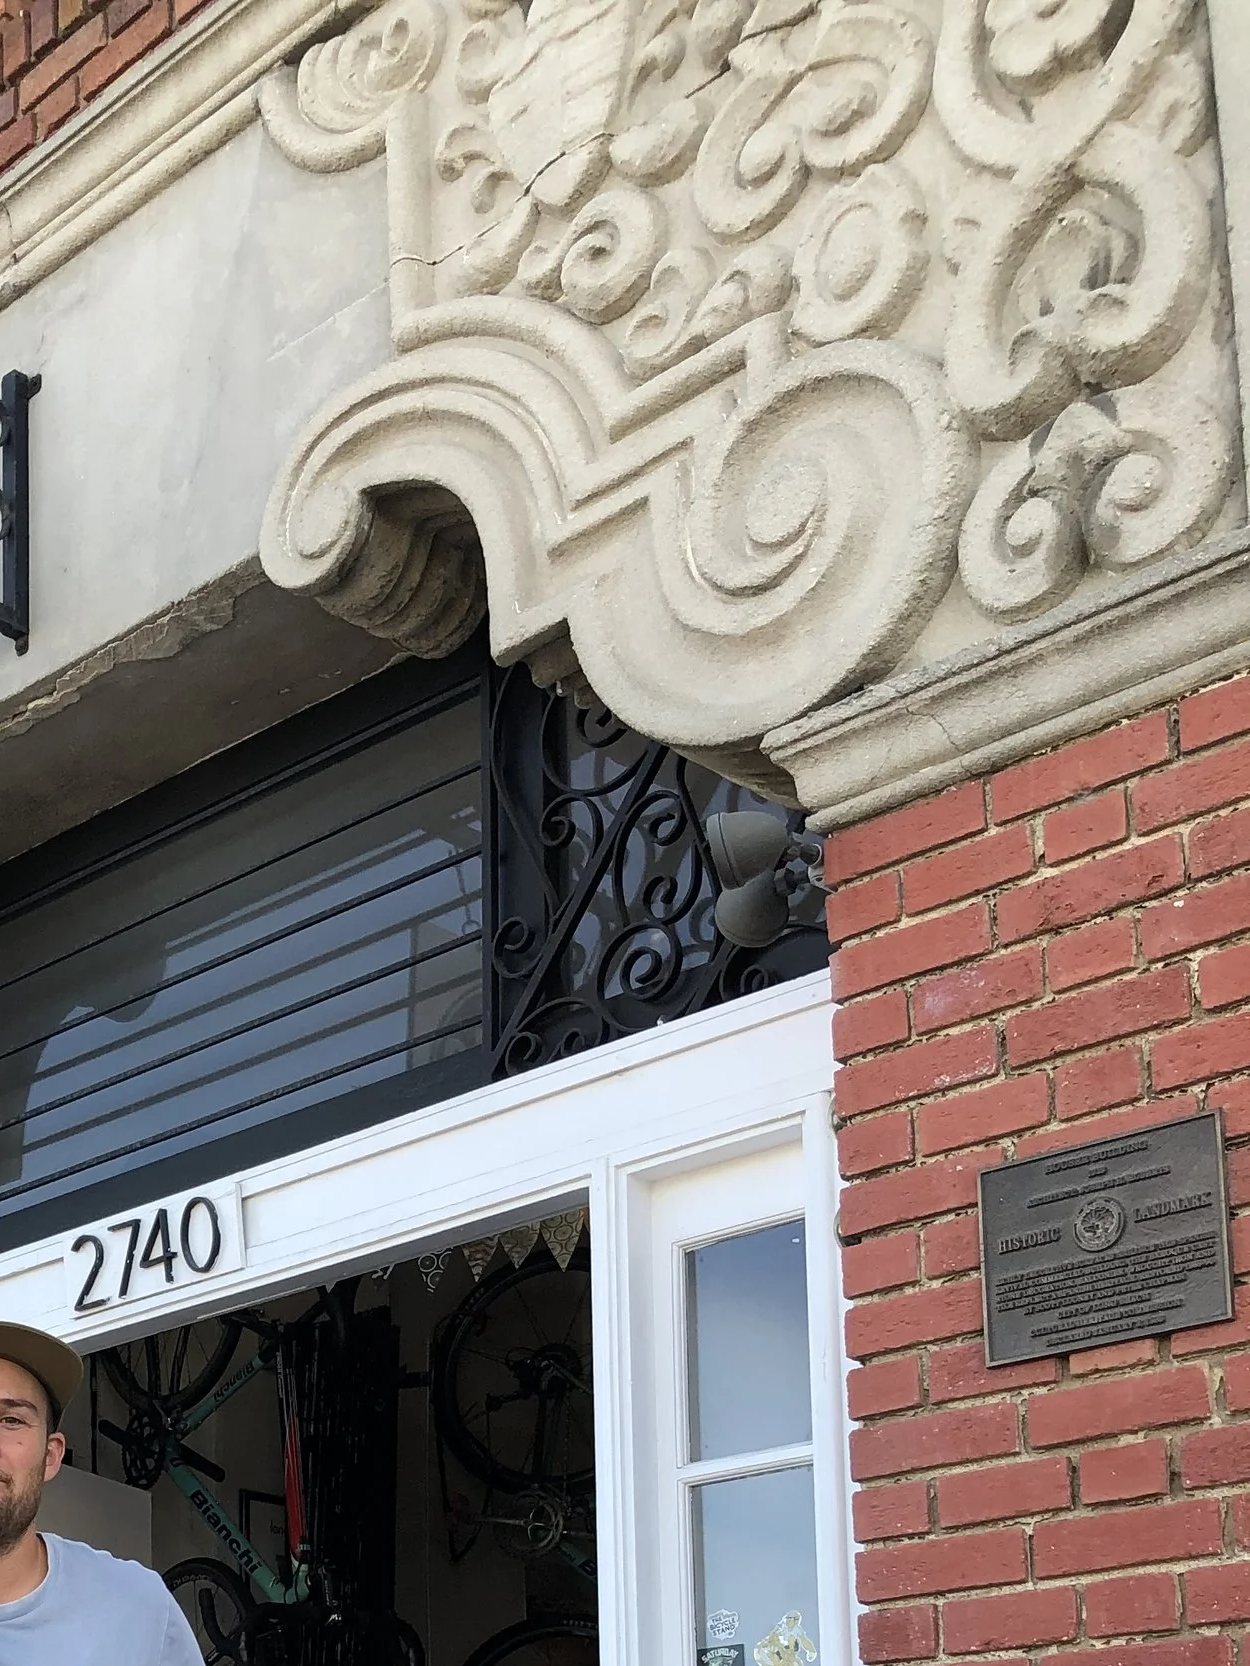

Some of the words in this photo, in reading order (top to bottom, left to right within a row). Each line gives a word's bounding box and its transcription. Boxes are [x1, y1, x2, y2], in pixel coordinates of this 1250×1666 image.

[998, 1226, 1062, 1254] HISTORIC
[1134, 1192, 1212, 1222] LANDMARK
[71, 1197, 221, 1312] 2740
[213, 1361, 254, 1401] Bianchi
[190, 1489, 262, 1574] Bianchi
[710, 1618, 736, 1630] BICYCLE
[713, 1625, 735, 1636] STAND
[701, 1648, 739, 1663] SATURDAY
